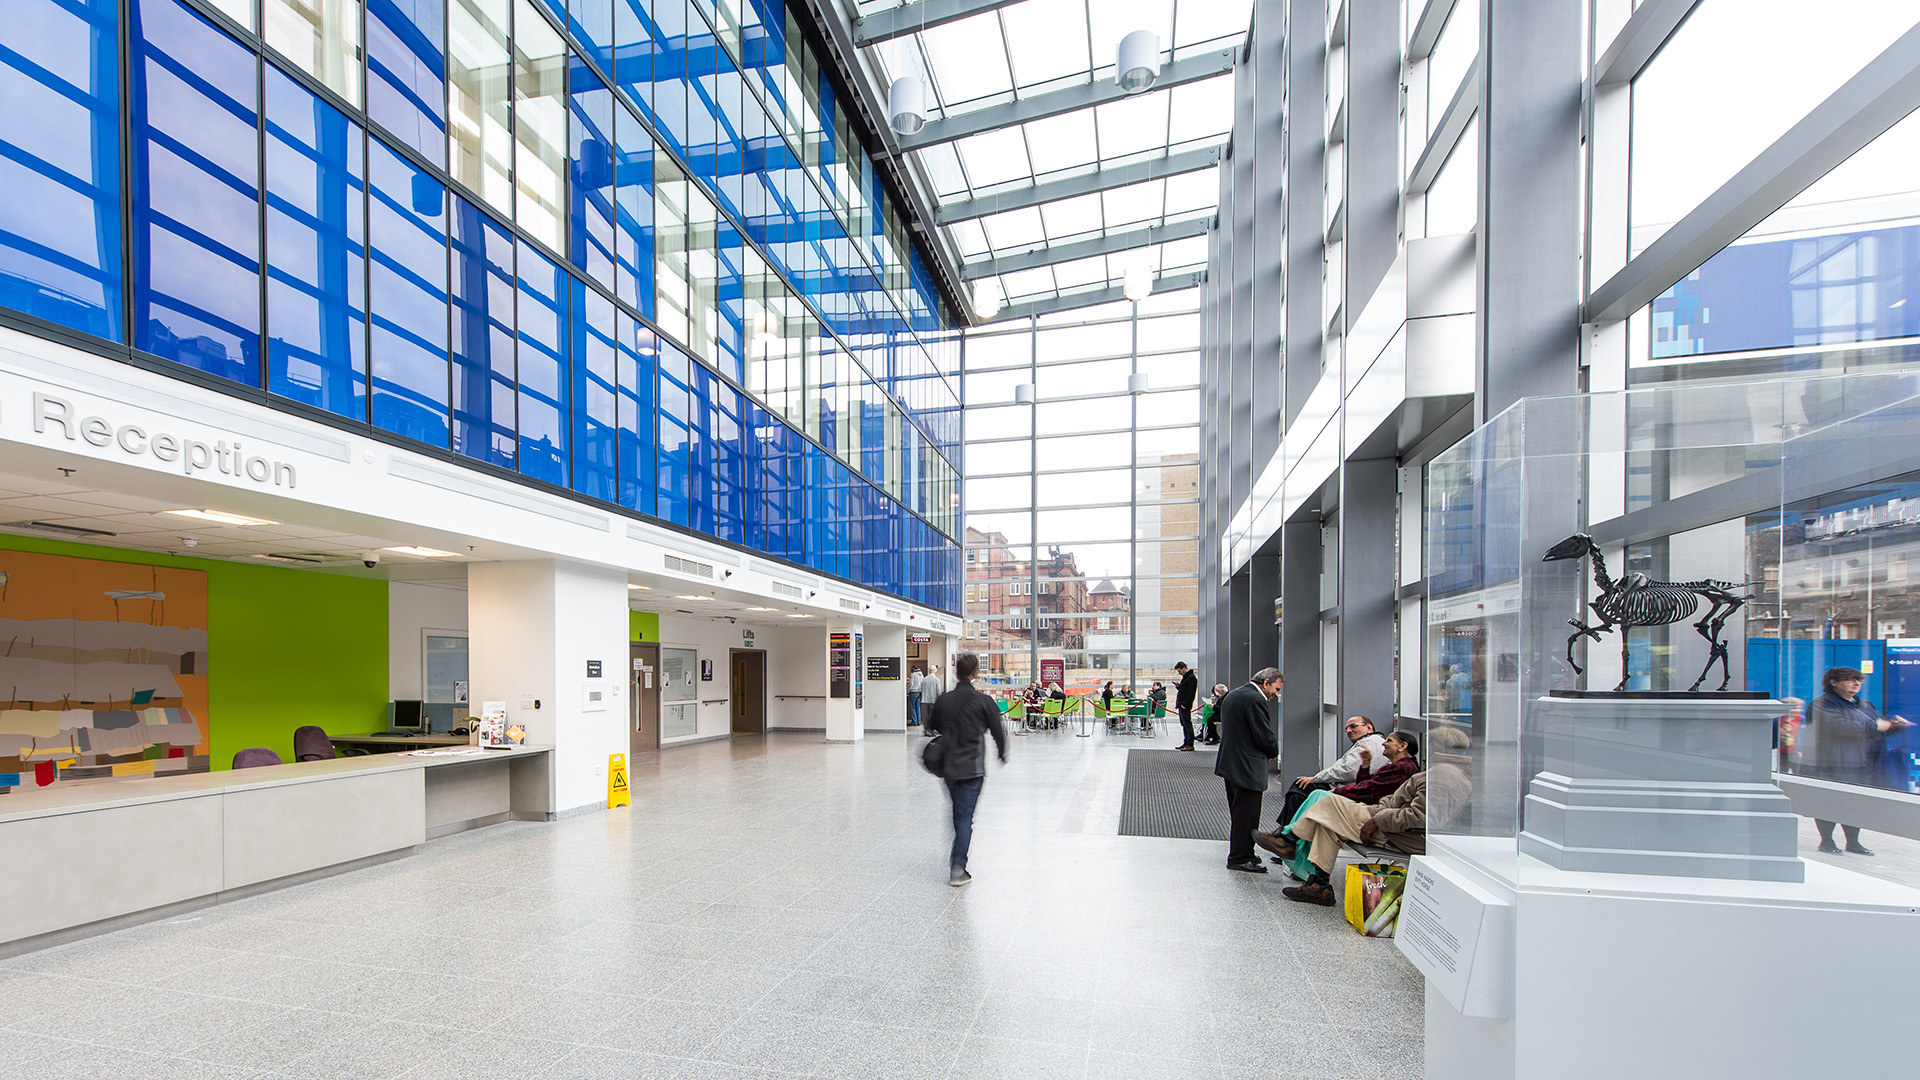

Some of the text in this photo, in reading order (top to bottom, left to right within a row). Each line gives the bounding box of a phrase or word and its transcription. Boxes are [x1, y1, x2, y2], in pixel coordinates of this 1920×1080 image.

[33, 391, 297, 488] Reception
[742, 629, 755, 639] Lifts
[1366, 877, 1387, 894] fresh
